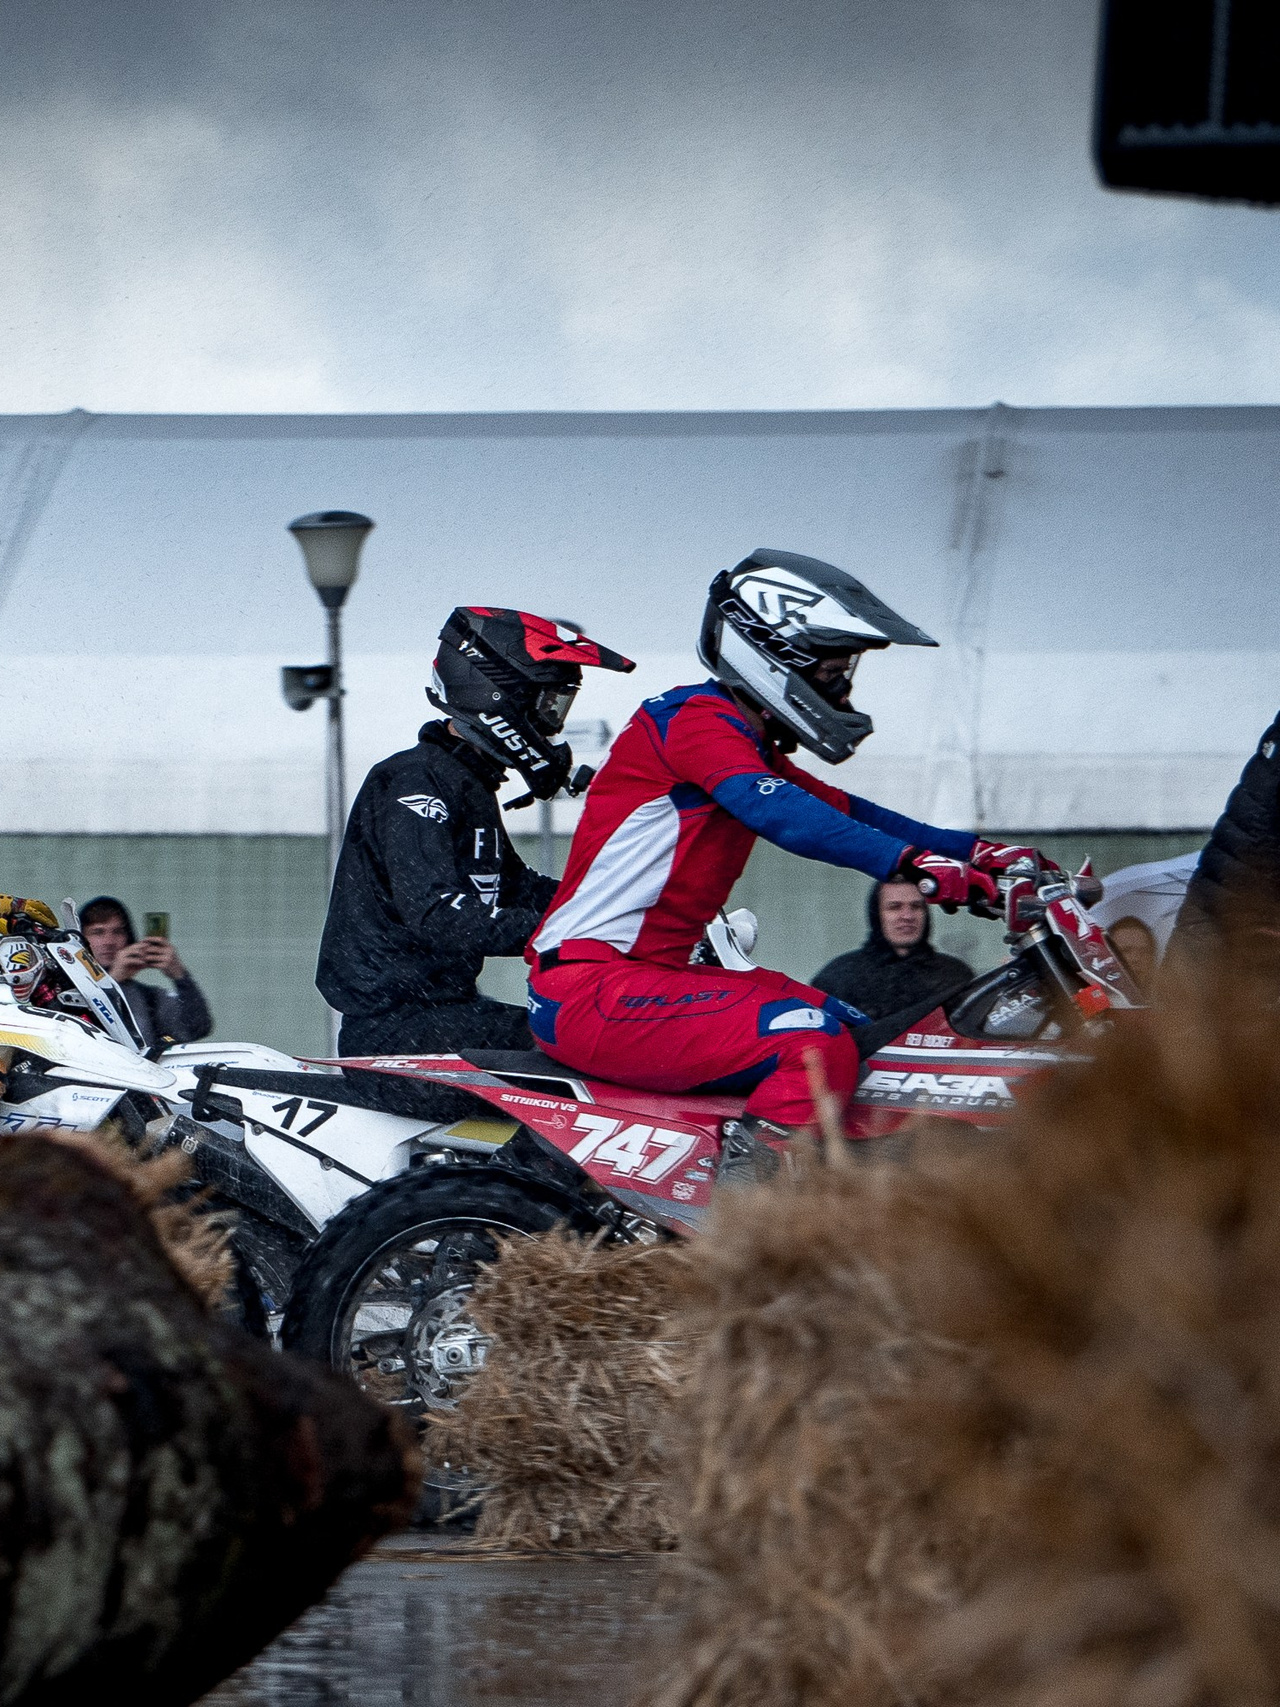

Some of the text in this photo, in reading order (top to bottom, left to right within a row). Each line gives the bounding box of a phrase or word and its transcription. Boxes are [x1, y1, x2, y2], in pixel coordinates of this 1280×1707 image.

[478, 712, 550, 772] JUST1
[272, 1096, 339, 1138] 17
[500, 1093, 578, 1112] SITNIKOV VS
[568, 1113, 701, 1186] 747
